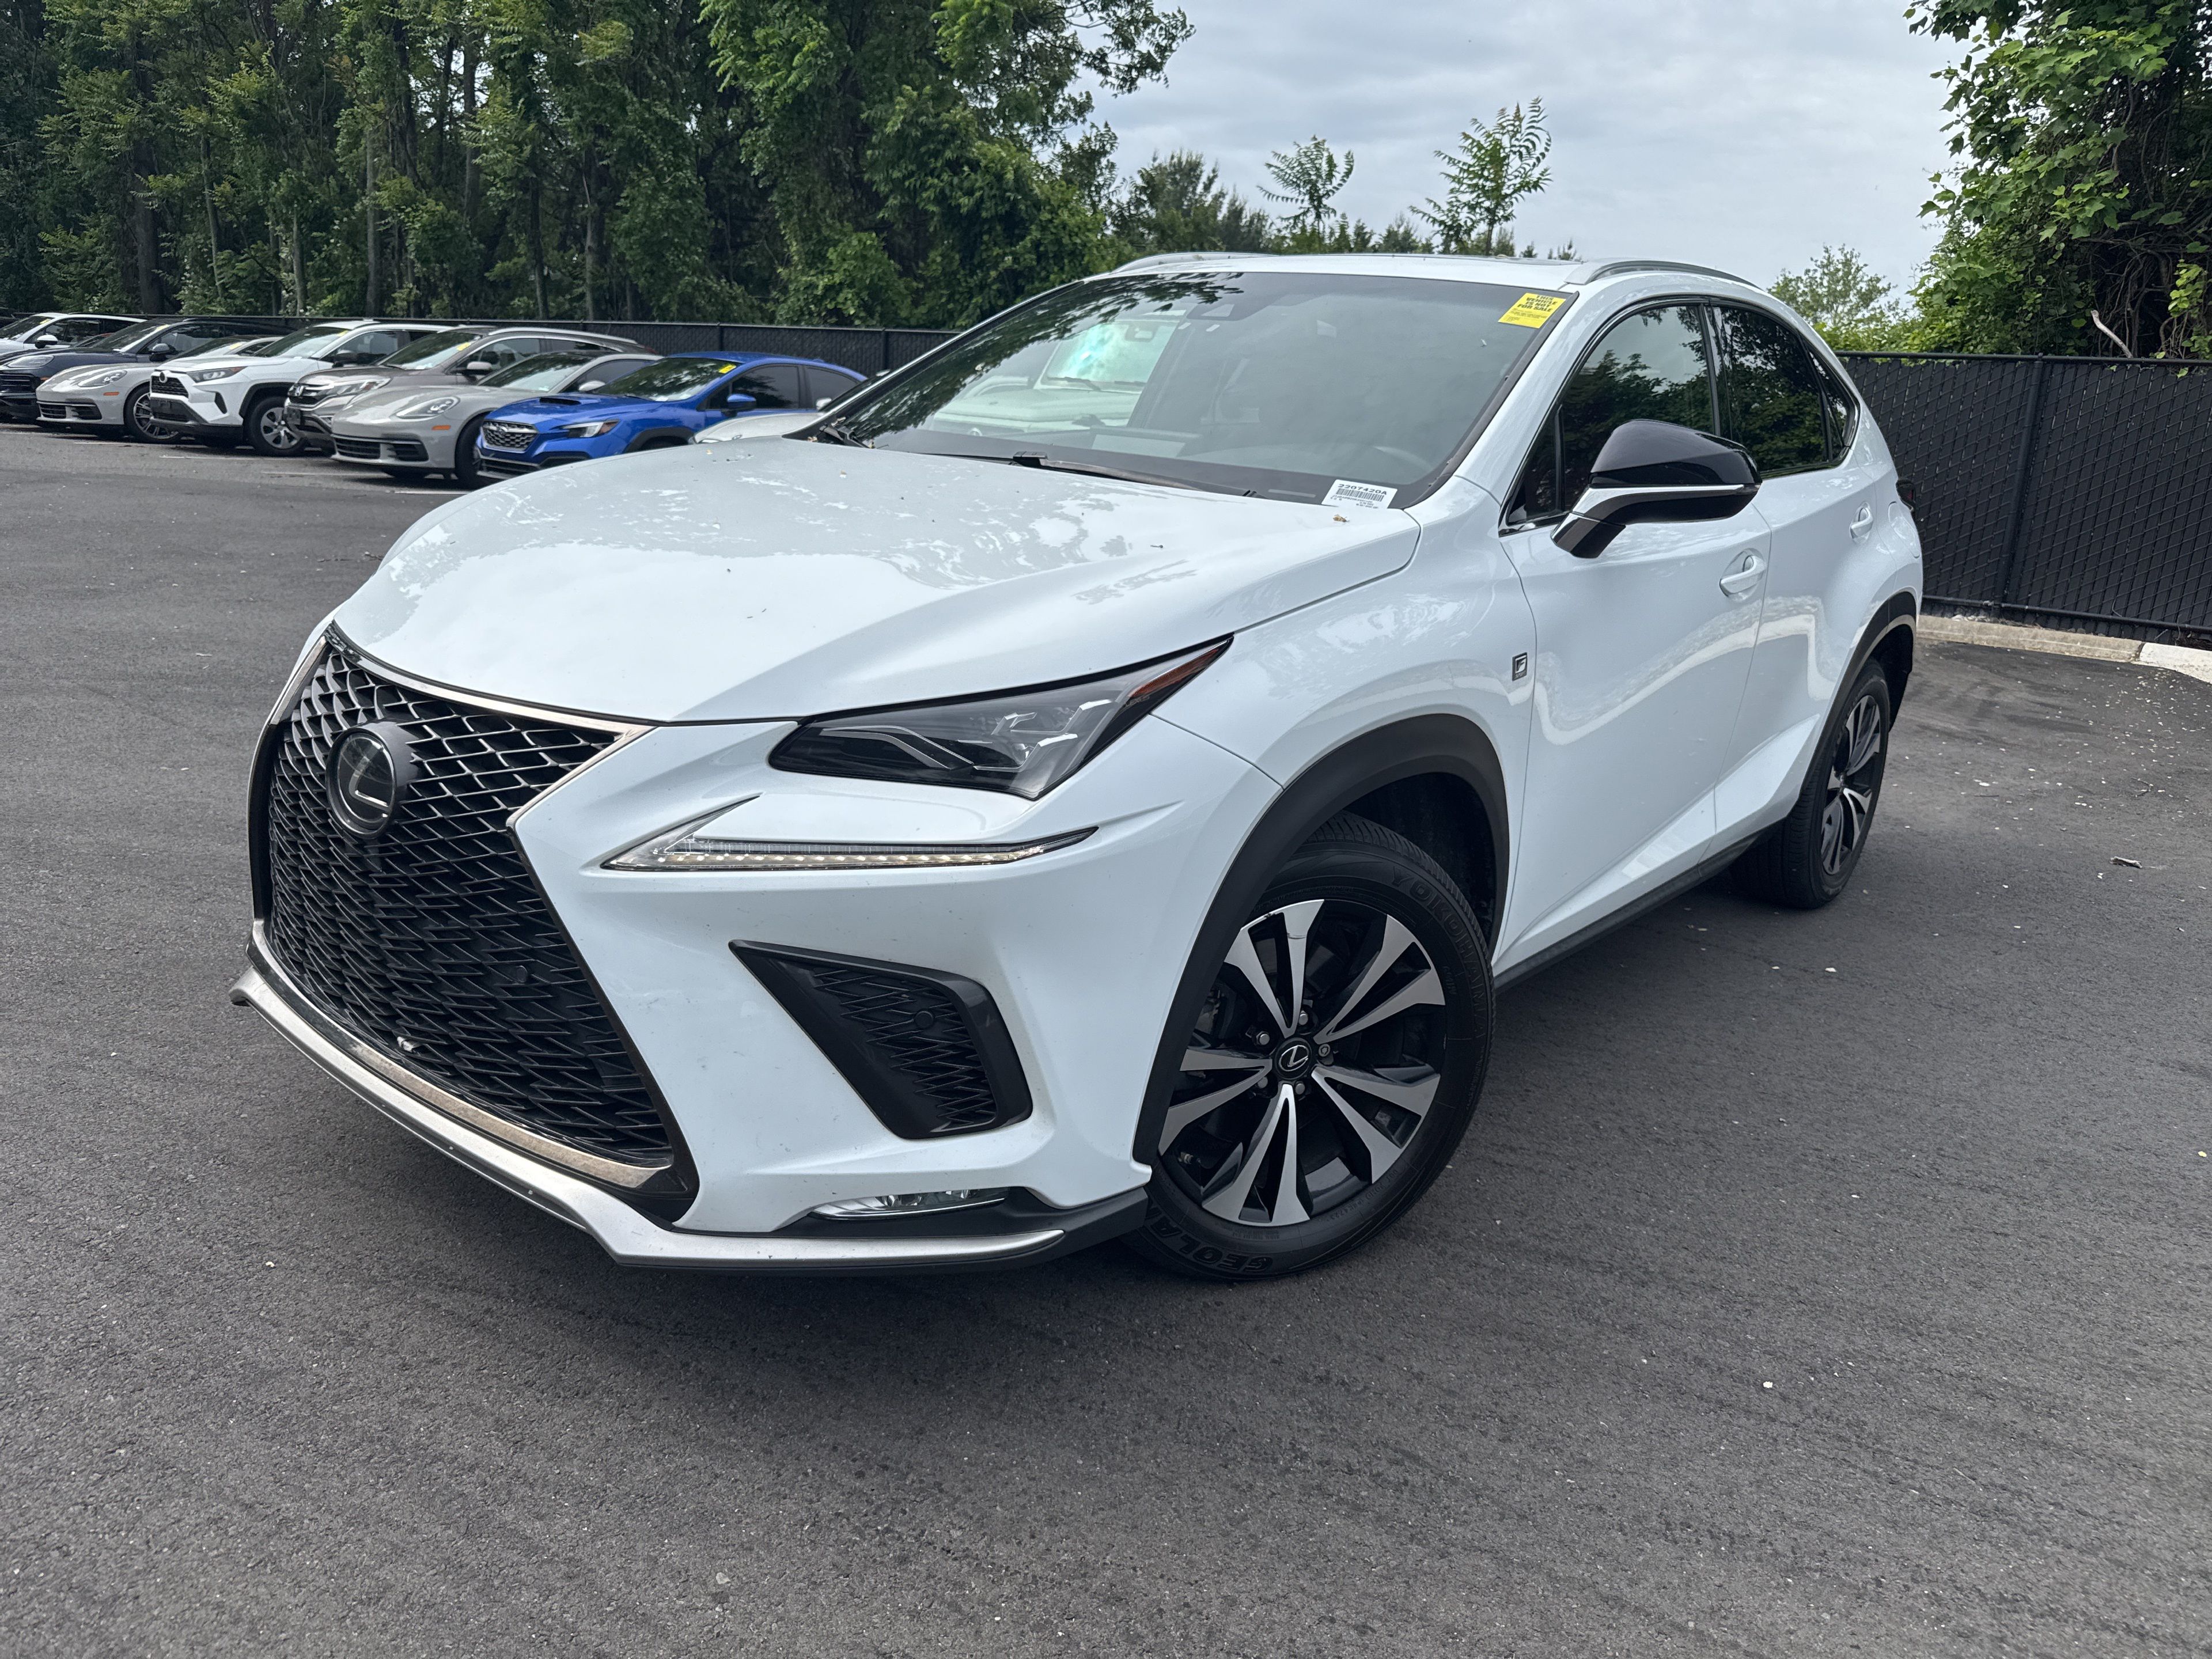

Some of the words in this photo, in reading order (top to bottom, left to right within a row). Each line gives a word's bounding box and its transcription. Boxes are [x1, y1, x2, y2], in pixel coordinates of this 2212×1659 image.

[1527, 297, 1558, 305] VEHICLE
[1338, 484, 1387, 495] 2207420A
[1391, 866, 1486, 1037] YOKOHAMA
